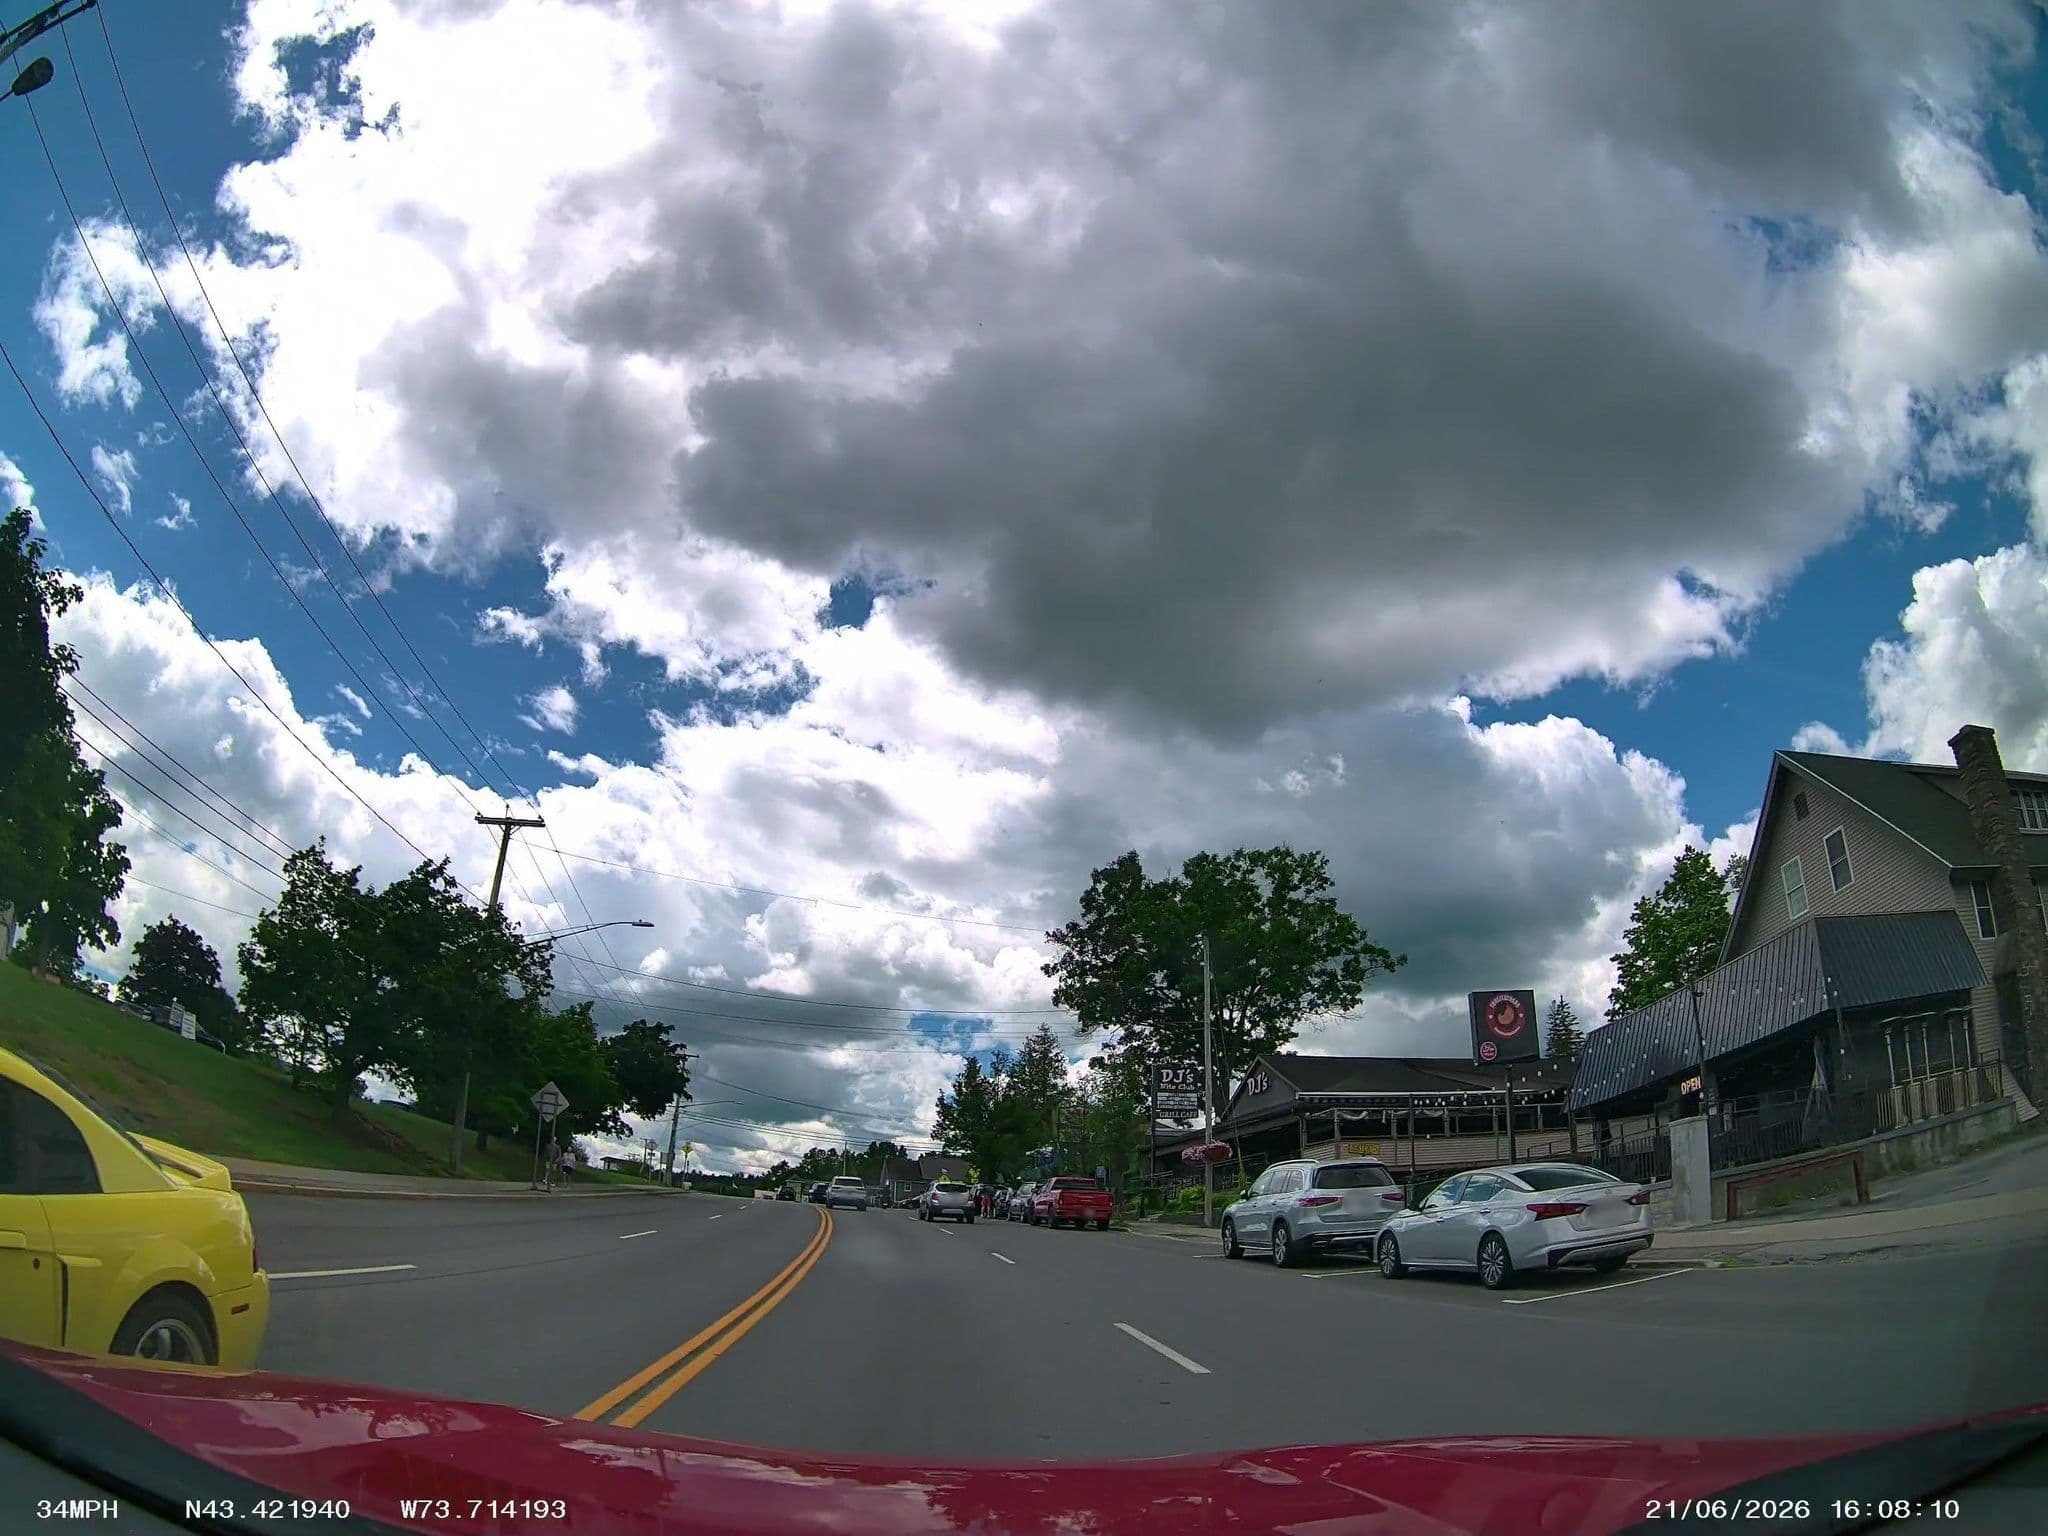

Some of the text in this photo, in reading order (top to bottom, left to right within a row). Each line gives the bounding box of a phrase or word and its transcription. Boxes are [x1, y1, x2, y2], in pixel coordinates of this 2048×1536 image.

[1160, 1068, 1194, 1083] DJ's
[1246, 1071, 1268, 1096] DJ's
[1680, 1075, 1702, 1095] OPEN
